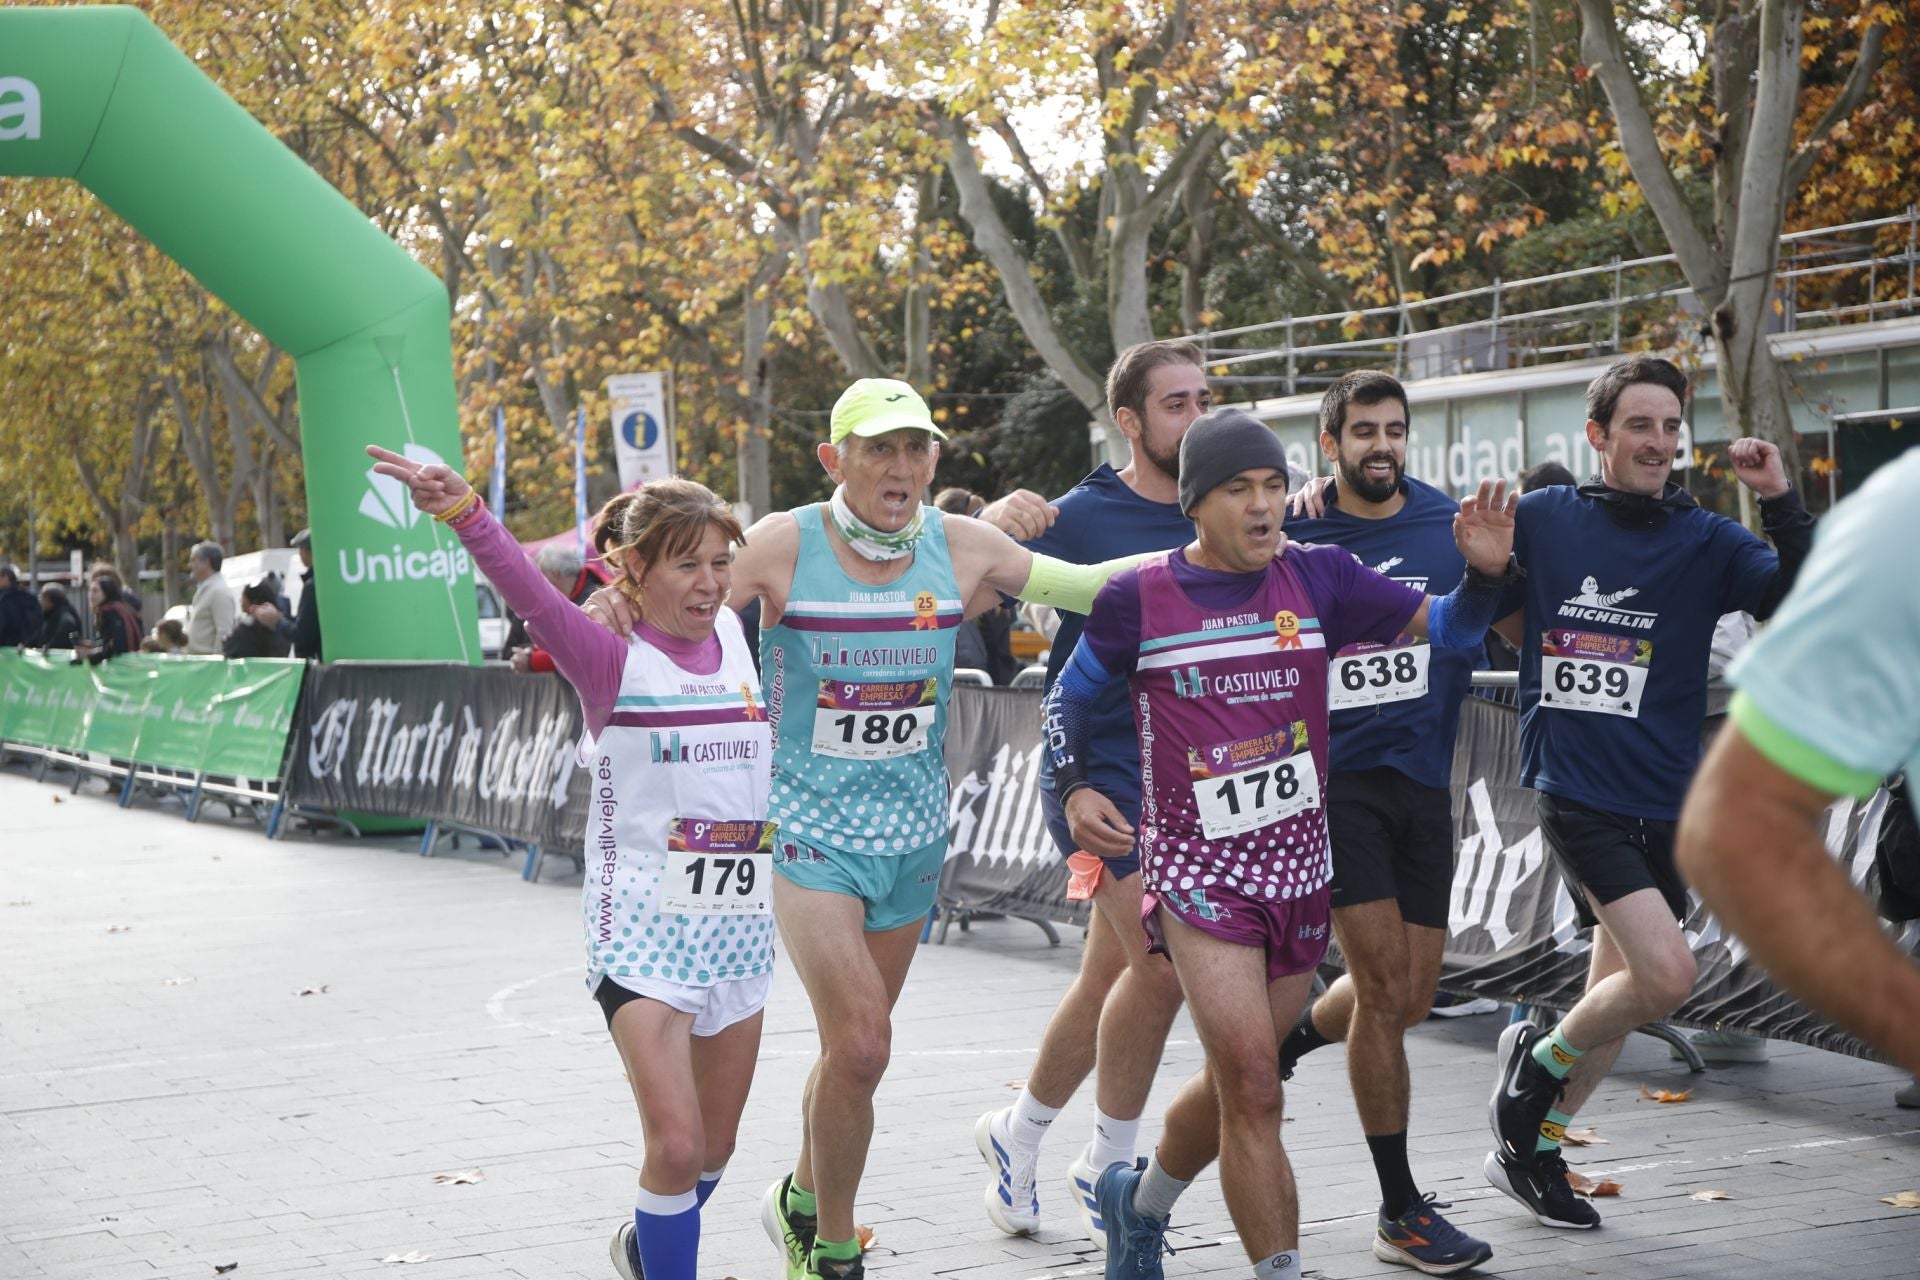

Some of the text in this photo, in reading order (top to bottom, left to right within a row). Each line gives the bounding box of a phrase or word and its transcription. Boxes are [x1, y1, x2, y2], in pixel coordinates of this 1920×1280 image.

[1408, 419, 1525, 489] iudad
[338, 539, 469, 587] Unicaja
[849, 591, 906, 603] JUAN PASTOR
[918, 597, 933, 609] 25
[1201, 612, 1260, 631] JUAN PASTOR
[1278, 615, 1295, 629] 25
[1557, 604, 1656, 629] MICHELIN
[1575, 640, 1617, 653] EMPRESAS
[1576, 633, 1618, 645] CARRERA DE
[853, 647, 937, 667] CASTILVIEJO
[1215, 667, 1300, 694] CASTILVIEJO
[1340, 651, 1418, 691] 638
[1554, 661, 1629, 698] 639
[698, 684, 728, 695] PASTOR
[860, 683, 905, 693] CARRERA DE
[860, 691, 904, 701] EMPRESAS
[834, 713, 918, 744] 180
[1228, 733, 1274, 752] CARRERA DE
[1230, 742, 1276, 762] EMPRESAS
[1216, 763, 1299, 816] 178
[710, 832, 746, 842] EMPRESAS
[711, 823, 746, 833] CARRERA DE
[598, 755, 618, 944] www.castilviejo.es
[1448, 777, 1543, 953] de
[685, 857, 756, 896] 179
